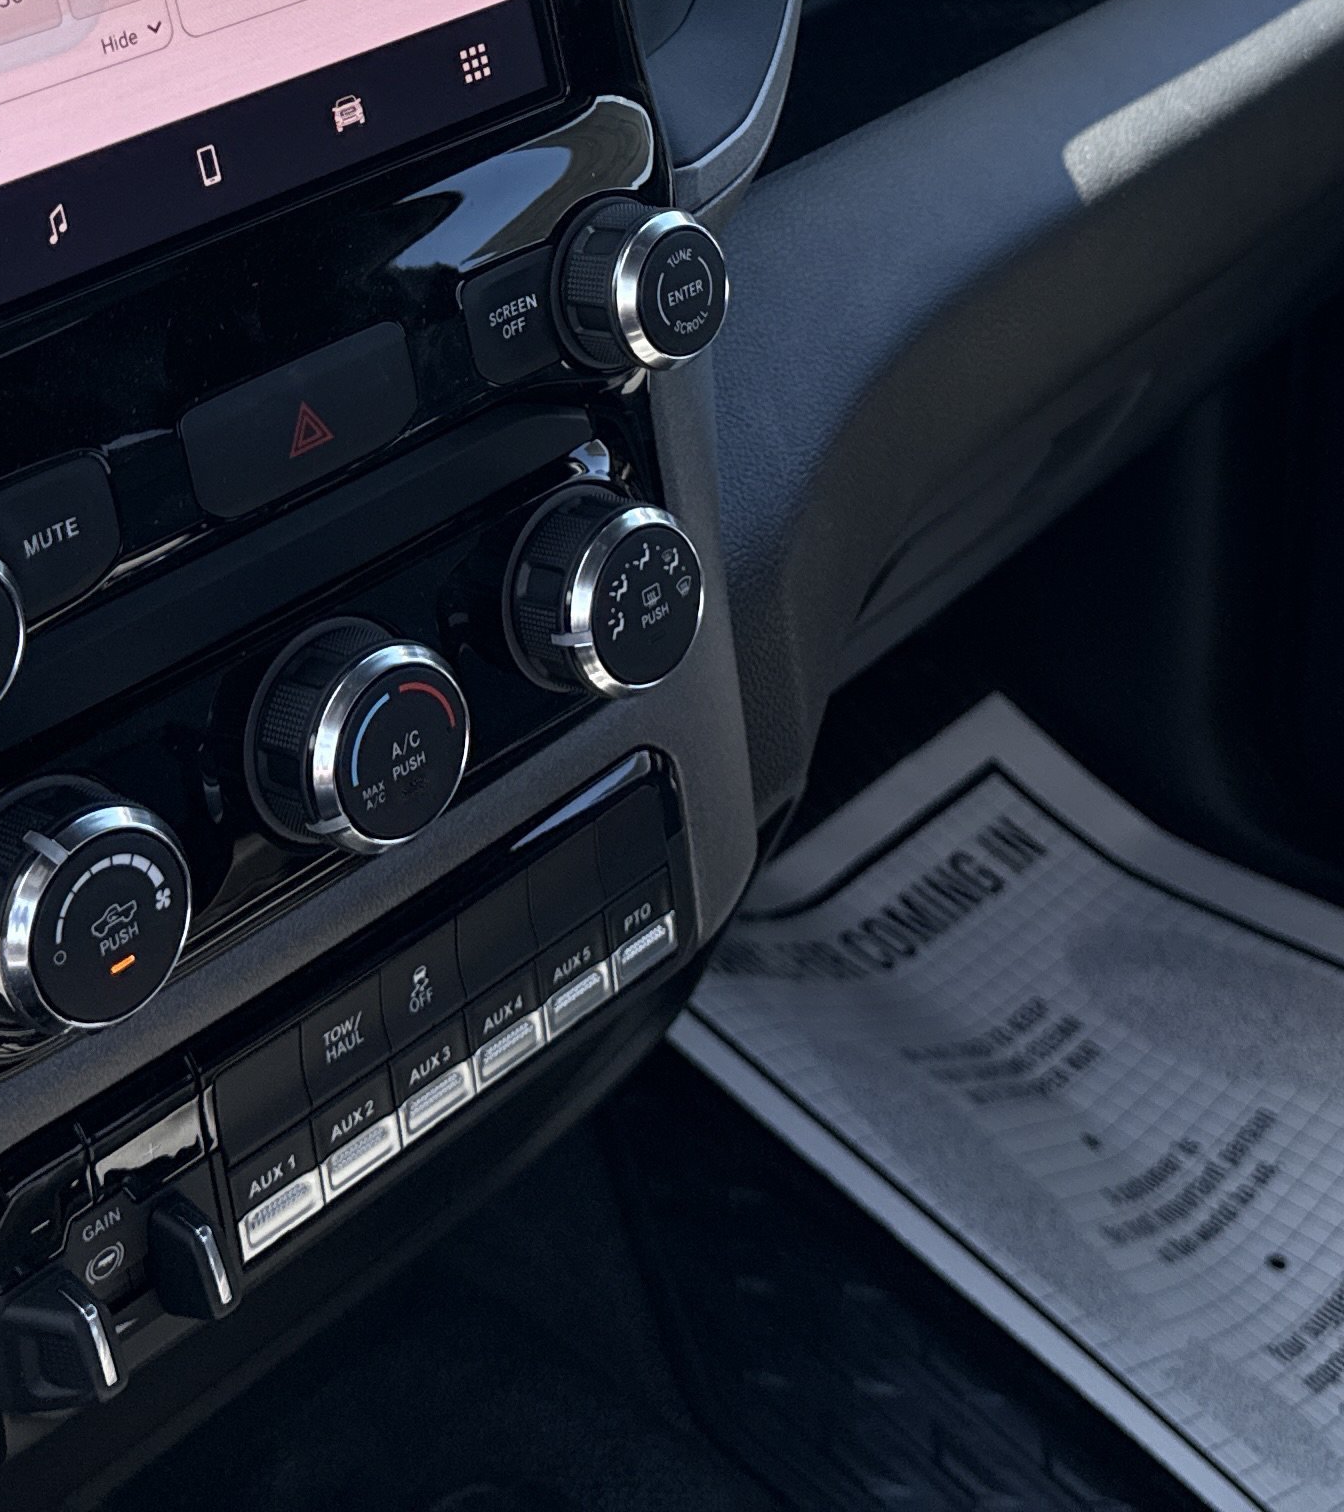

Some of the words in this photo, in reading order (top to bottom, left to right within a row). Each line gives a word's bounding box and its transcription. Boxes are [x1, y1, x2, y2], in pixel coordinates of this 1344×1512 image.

[100, 29, 139, 55] Hide
[666, 248, 693, 268] TUNE
[667, 279, 704, 307] ENTER
[488, 293, 538, 327] SCREEN
[674, 310, 709, 335] SCROLL
[502, 316, 526, 339] OFF
[23, 516, 81, 559] MUTE
[640, 601, 671, 629] PUSH
[391, 728, 421, 761] A/C
[391, 750, 427, 782] PUSH
[362, 779, 387, 801] MAX
[366, 790, 387, 812] A/C
[839, 848, 1007, 972] COMING
[976, 815, 1050, 876] IN
[623, 902, 653, 933] PTO
[99, 922, 141, 958] PUSH
[552, 952, 583, 985] AUX
[582, 945, 593, 962] 5
[408, 987, 434, 1014] OFF
[482, 1001, 514, 1035] AUX
[513, 993, 524, 1011] 4
[322, 1010, 364, 1046] TOW/
[324, 1029, 366, 1064] HAUL
[408, 1052, 441, 1086] AUX
[440, 1044, 453, 1062] 3
[330, 1107, 364, 1143] AUX
[364, 1098, 376, 1118] 2
[247, 1164, 286, 1199] AUX
[286, 1153, 298, 1171] 1
[81, 1207, 123, 1243] GAIN
